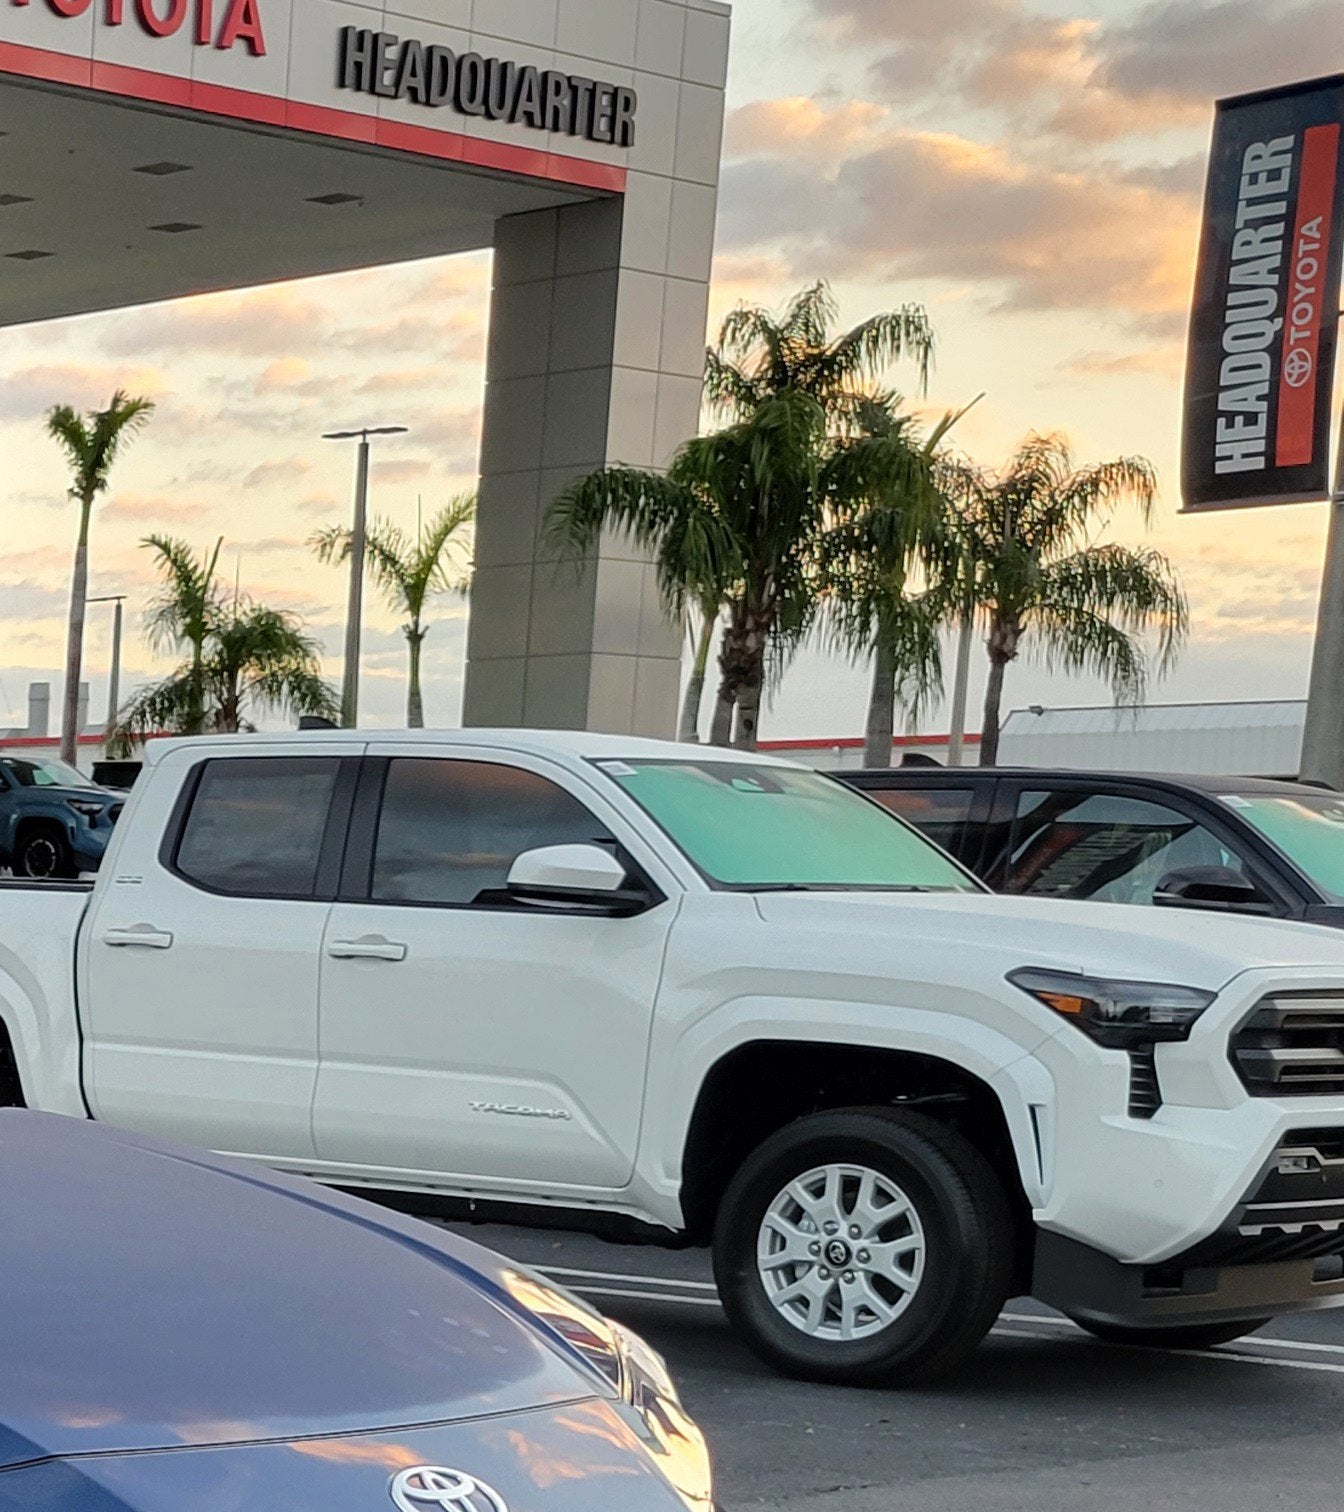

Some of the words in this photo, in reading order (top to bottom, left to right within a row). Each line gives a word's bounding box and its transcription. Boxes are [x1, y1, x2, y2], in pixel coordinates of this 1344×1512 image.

[337, 26, 637, 147] HEADQUARTER
[1214, 133, 1295, 475] HEADQUARTER
[1289, 215, 1324, 345] TOYOTA
[468, 1101, 571, 1120] TACOMA
